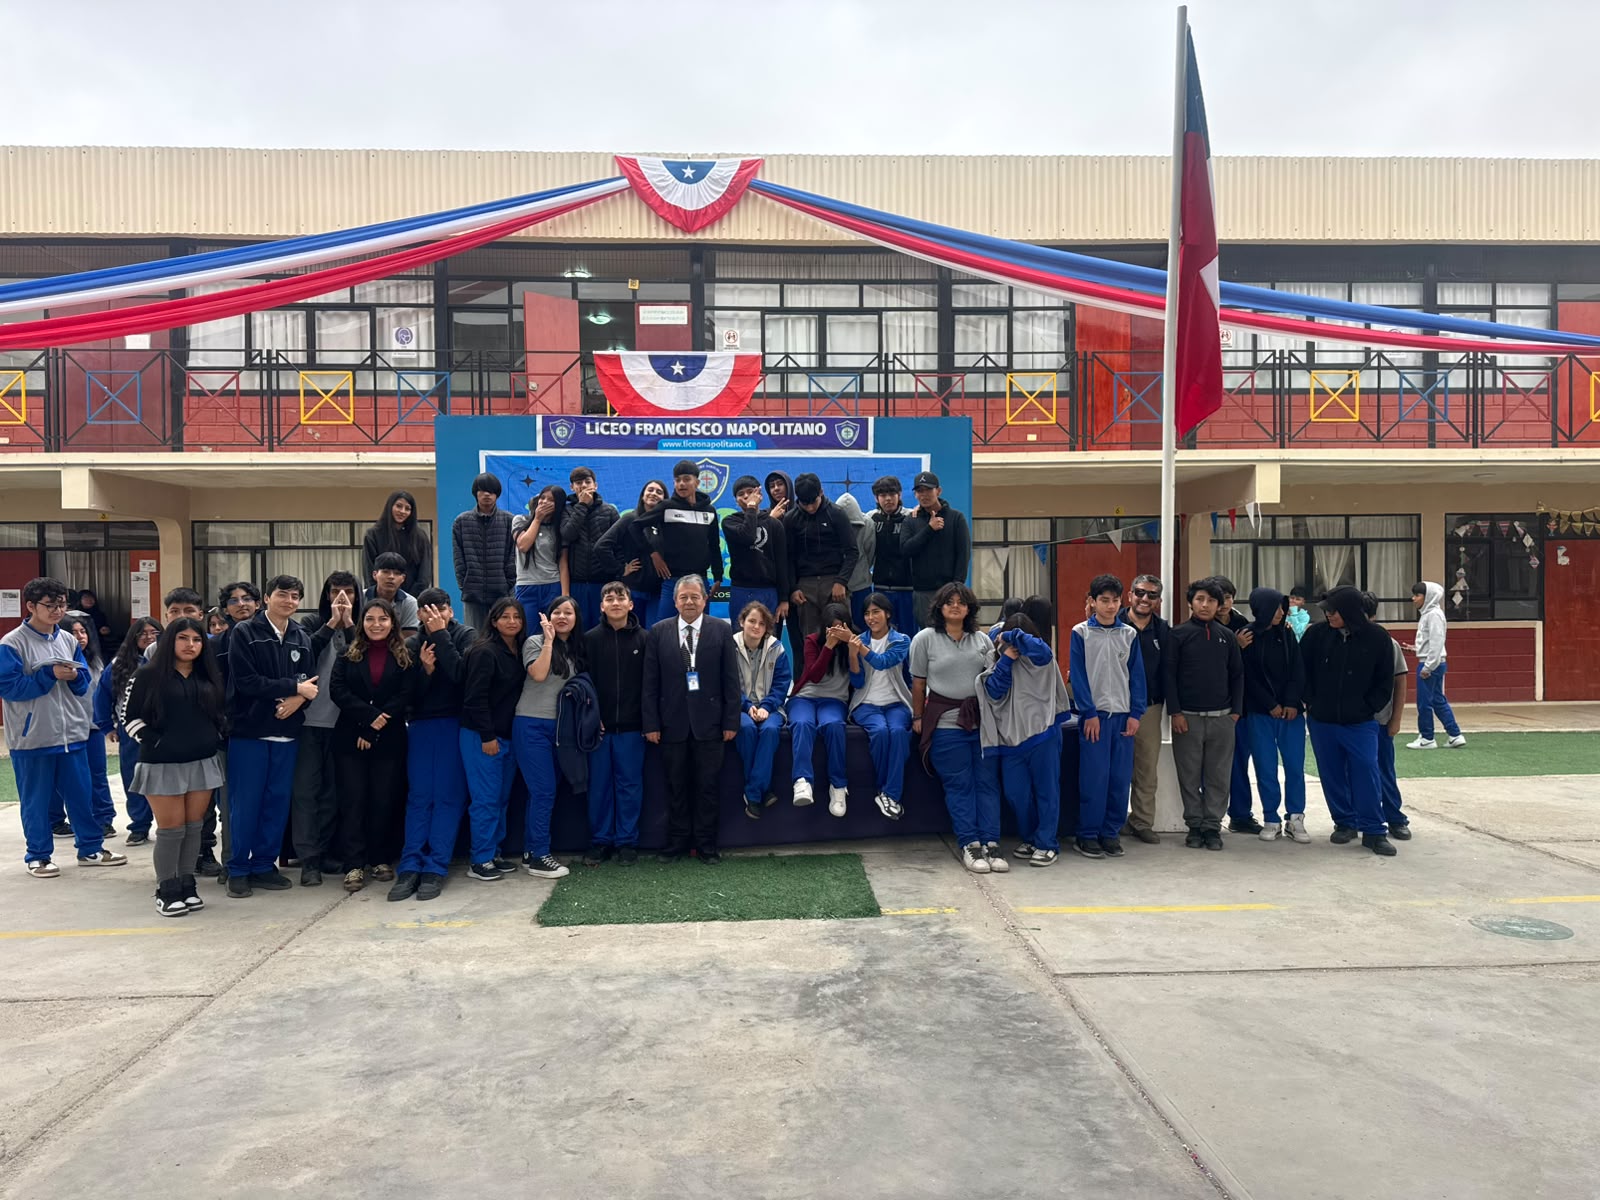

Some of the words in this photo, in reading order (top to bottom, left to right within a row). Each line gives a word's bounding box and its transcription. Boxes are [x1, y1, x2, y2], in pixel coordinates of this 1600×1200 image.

[585, 422, 631, 436] LICEO
[634, 422, 723, 436] FRANCISCO
[726, 422, 827, 436] NAPOLITANO
[662, 440, 752, 449] www.liceonapolitano.cl
